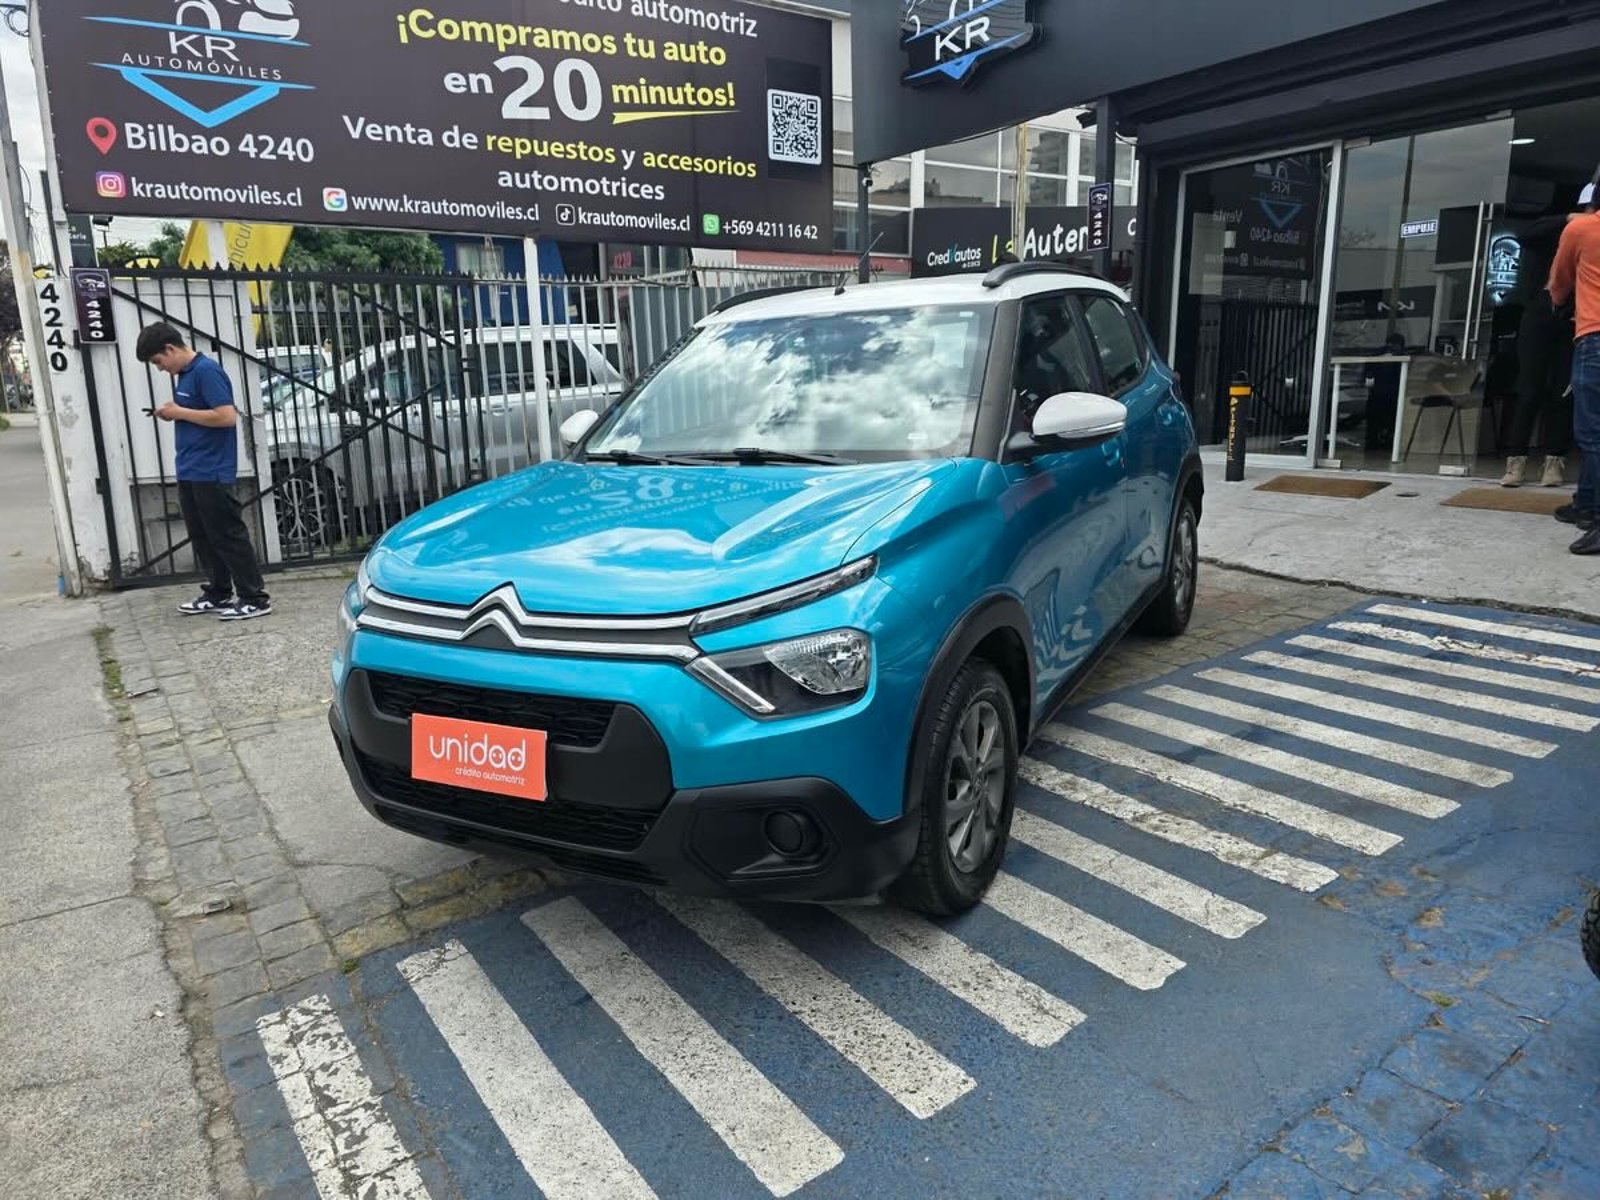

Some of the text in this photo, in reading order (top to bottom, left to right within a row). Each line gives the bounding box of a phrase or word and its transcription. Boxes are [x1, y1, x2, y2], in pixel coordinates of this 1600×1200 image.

[397, 8, 726, 66] ¡Compramos tu auto
[631, 0, 758, 37] automotriz
[168, 31, 241, 62] KR
[935, 16, 991, 62] KR
[121, 52, 282, 80] AUTOMÓVILES
[443, 55, 736, 122] en 20 minutos!
[125, 122, 315, 163] Bilbao 4240
[342, 115, 757, 178] Venta de repuestos y accesorios
[498, 170, 665, 200] automotrices
[130, 177, 303, 207] krautomoviles.cl
[351, 195, 540, 221] www.krautomoviles.cl
[578, 206, 691, 232] krautomoviles.cl
[723, 219, 754, 236] +569
[755, 220, 784, 237] 4211
[39, 282, 68, 372] 4240
[86, 300, 104, 339] 4240
[429, 733, 527, 772] unidad
[482, 771, 525, 786] automotriz
